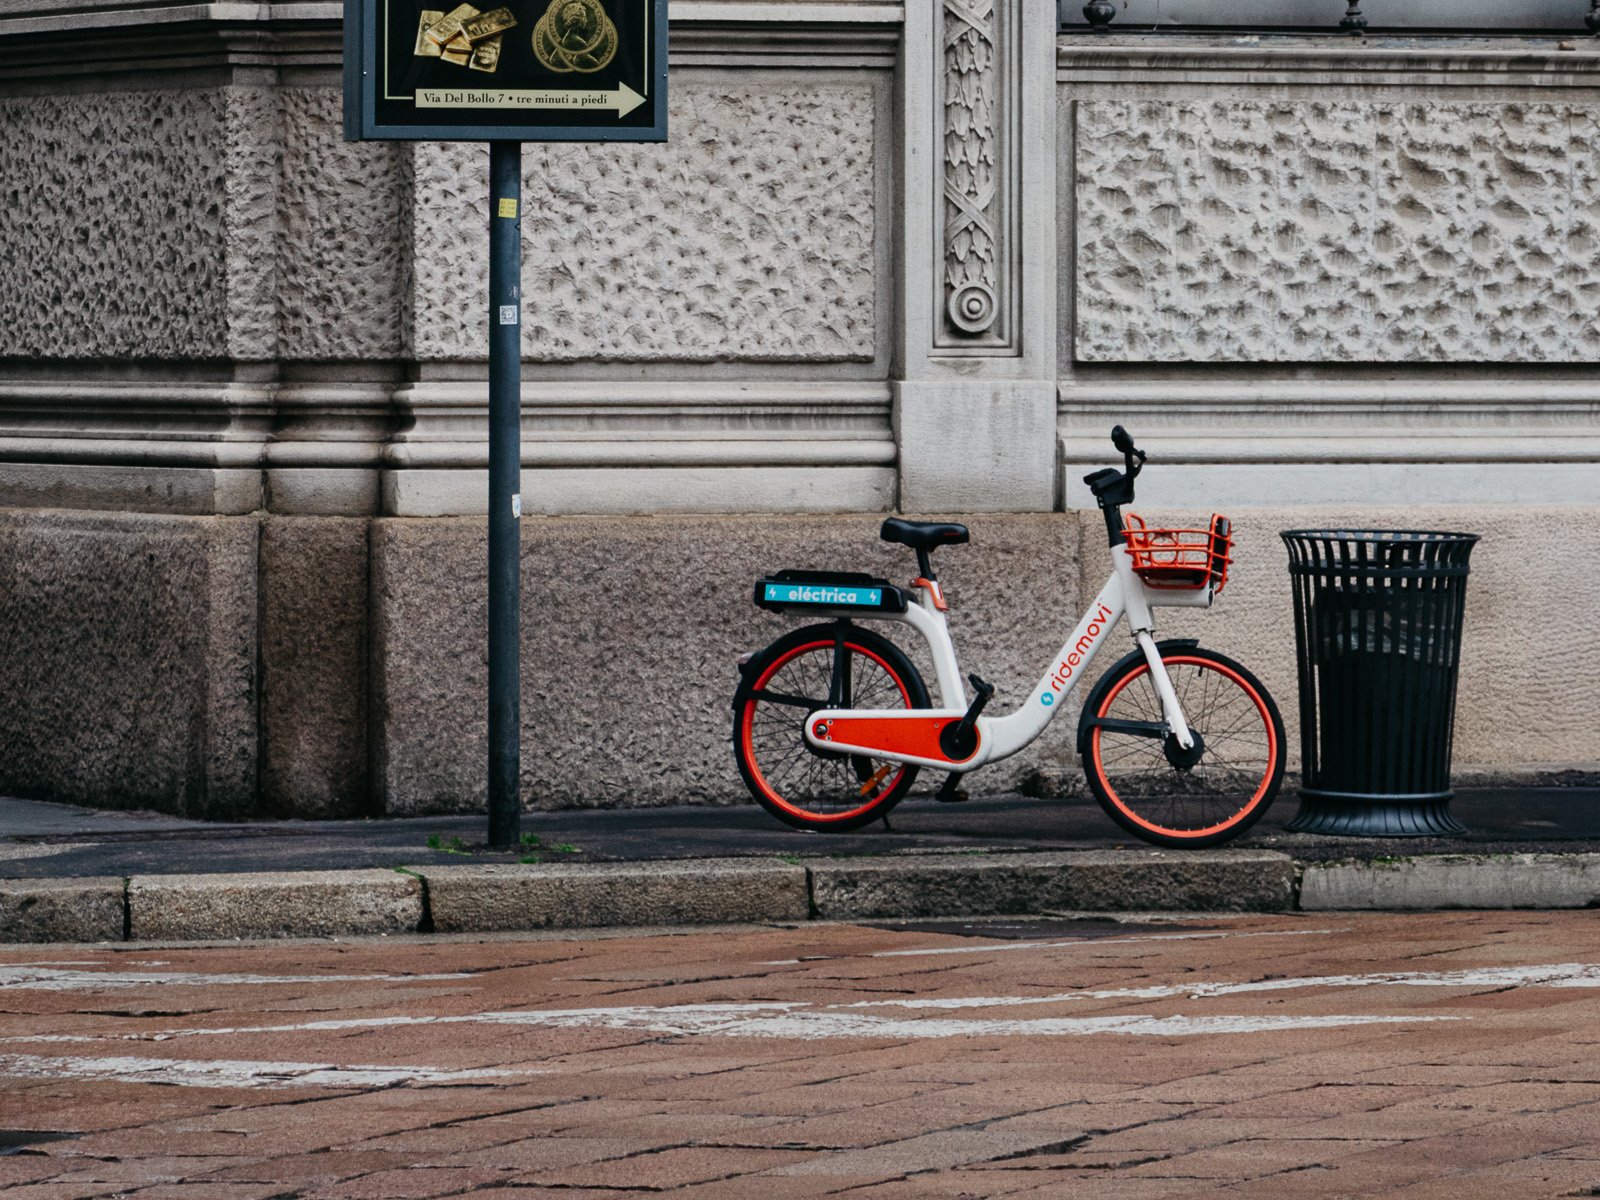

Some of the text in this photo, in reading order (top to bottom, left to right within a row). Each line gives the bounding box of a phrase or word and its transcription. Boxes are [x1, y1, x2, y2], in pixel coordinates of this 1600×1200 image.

[423, 93, 607, 107] Via Del Bollo 7 tre minuti a piedi
[788, 586, 857, 603] eléctrica
[1051, 603, 1113, 692] ridemovi
